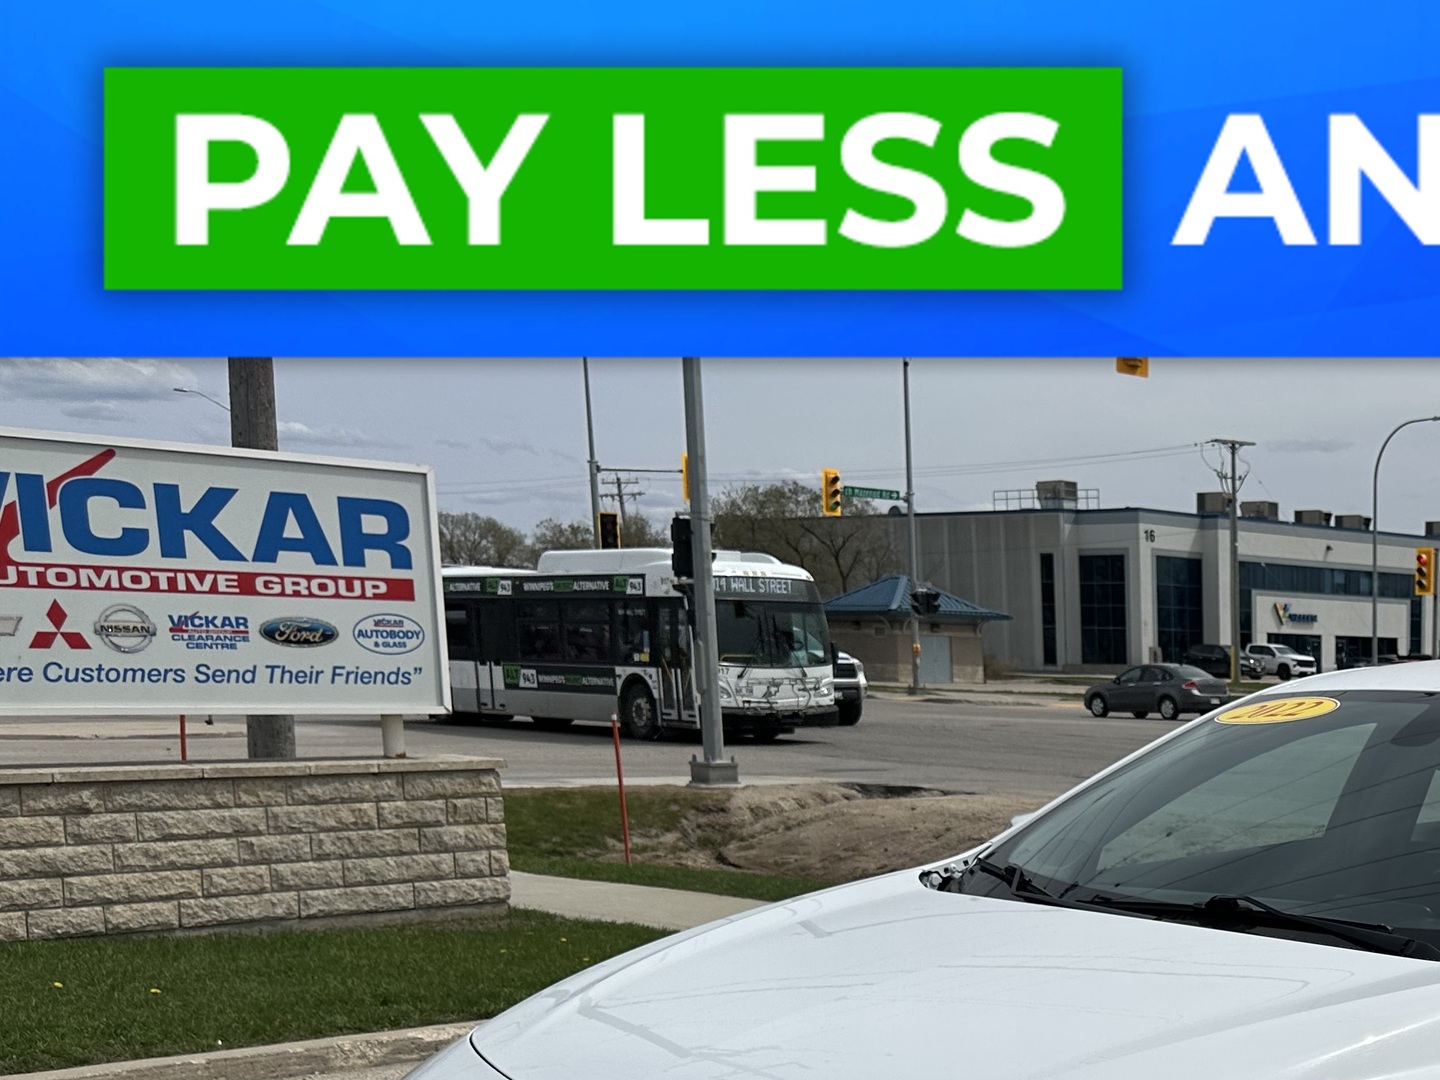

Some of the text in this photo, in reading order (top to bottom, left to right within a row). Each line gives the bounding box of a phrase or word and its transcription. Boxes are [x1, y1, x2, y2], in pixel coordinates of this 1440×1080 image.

[0, 472, 413, 570] ICKAR
[1144, 529, 1156, 543] 16
[255, 575, 388, 598] GROUP
[731, 578, 756, 593] WALL
[759, 579, 793, 594] STREET
[101, 623, 151, 635] NISSAN
[168, 614, 249, 629] VICKAR
[171, 634, 250, 643] CLEARANCE
[274, 620, 324, 643] Ford
[357, 629, 421, 640] AUTOBODY
[186, 642, 238, 650] CENTRE
[381, 641, 408, 649] GLASS
[43, 661, 186, 684] Customers
[194, 663, 257, 684] Send
[265, 664, 324, 685] Their
[1227, 701, 1325, 720] 2022
